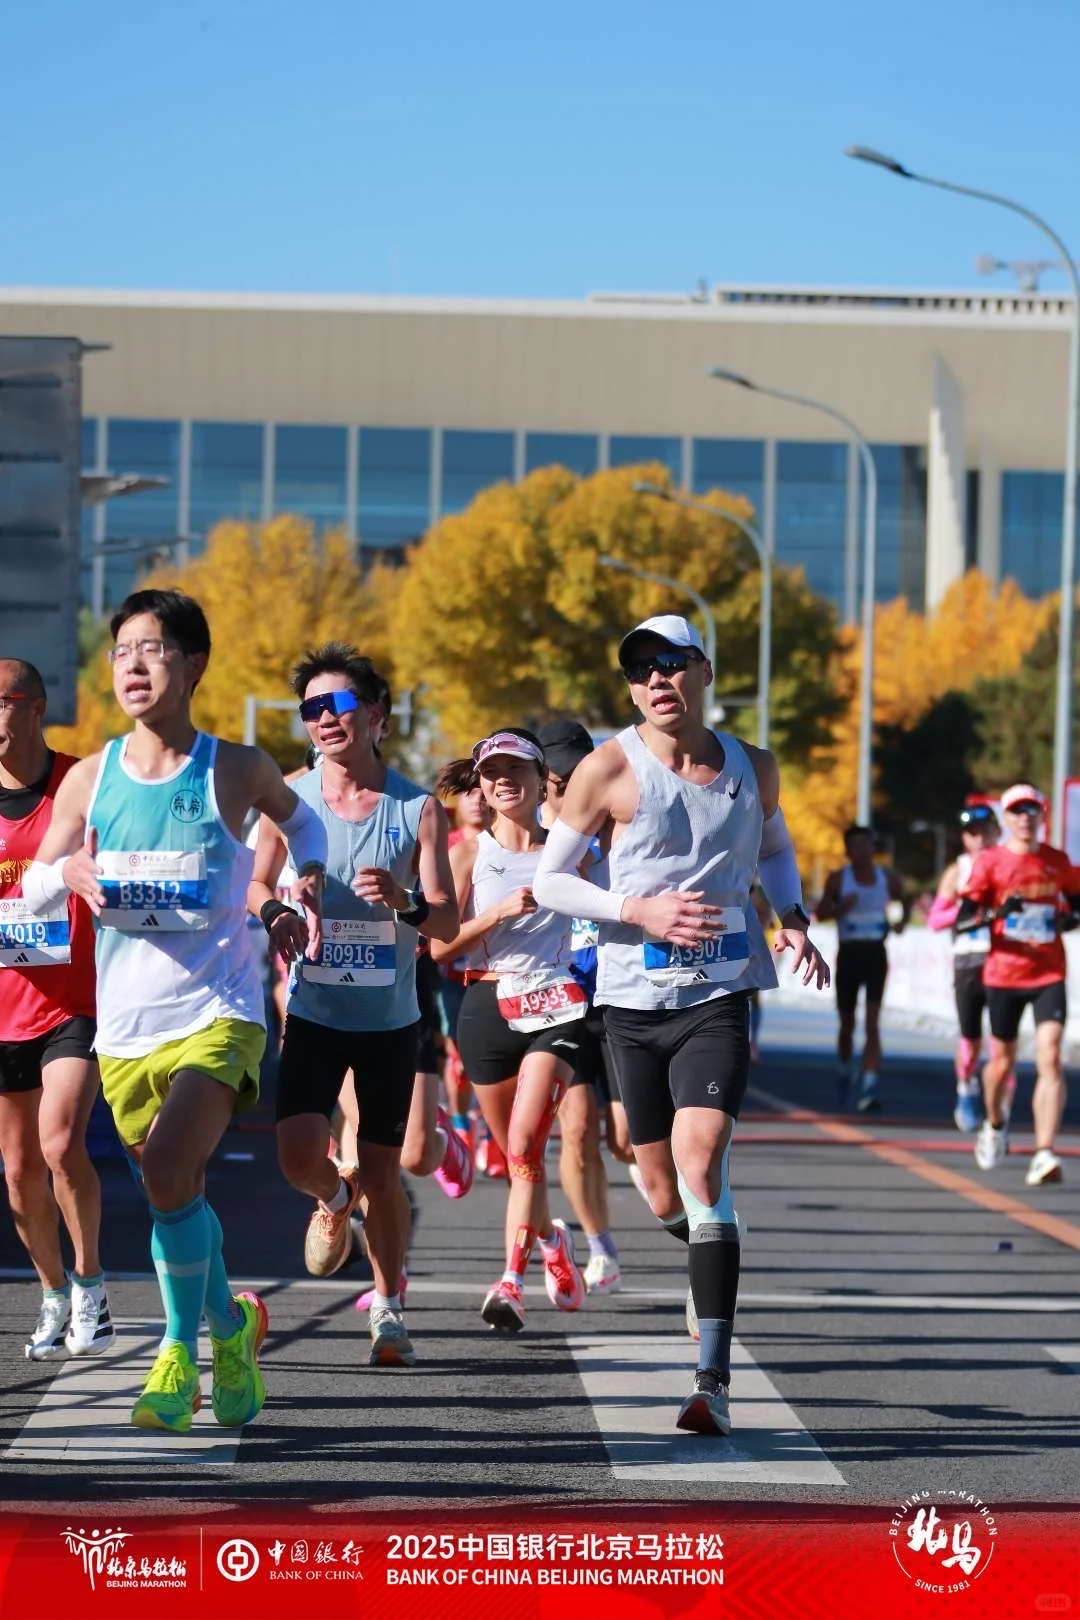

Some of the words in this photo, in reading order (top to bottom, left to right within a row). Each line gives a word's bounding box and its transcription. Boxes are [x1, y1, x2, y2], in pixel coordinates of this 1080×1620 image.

[119, 881, 182, 904] B3312
[322, 943, 375, 964] B0916
[520, 985, 569, 1014] A9935
